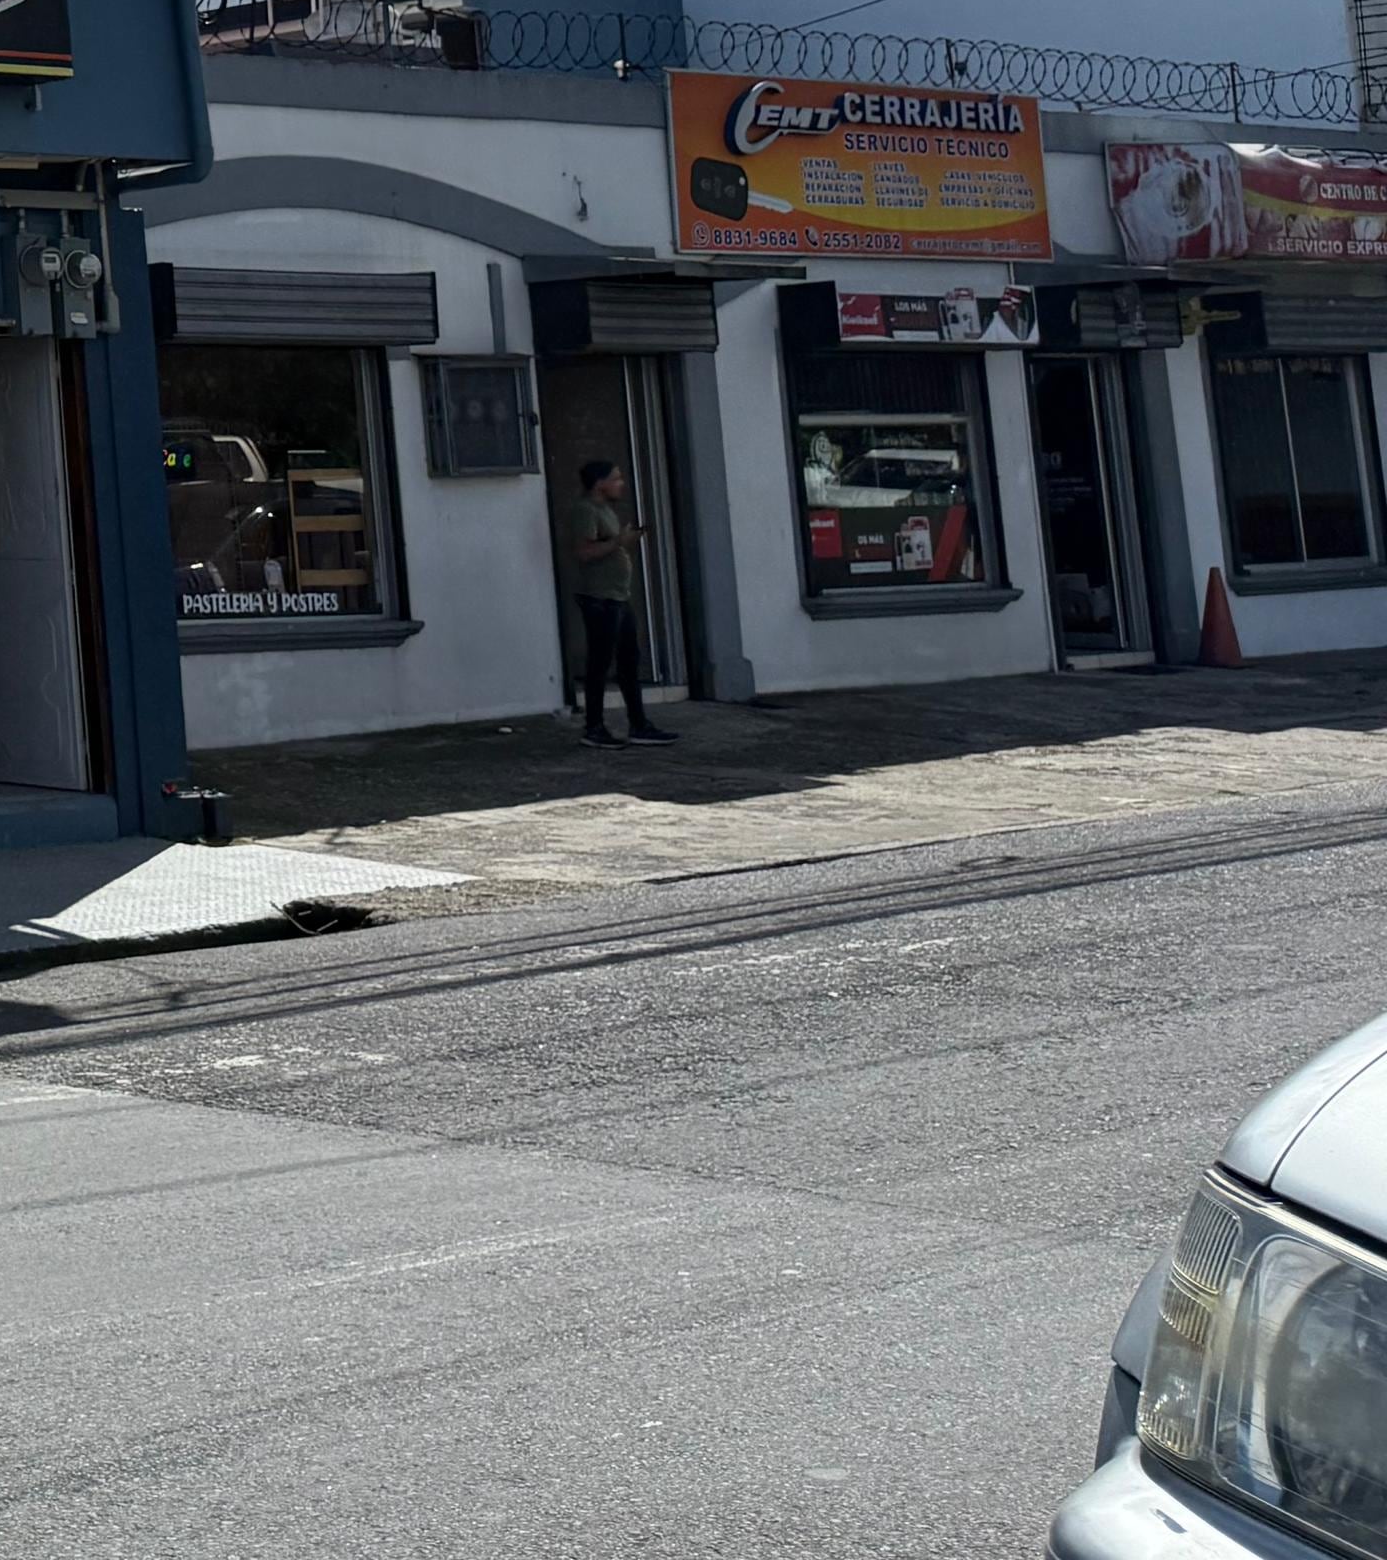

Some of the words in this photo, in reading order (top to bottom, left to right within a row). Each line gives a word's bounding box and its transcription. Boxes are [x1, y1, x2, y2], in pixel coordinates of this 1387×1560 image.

[842, 89, 1025, 133] CERRAJERÍA
[844, 133, 928, 154] SERVICIO
[1320, 183, 1361, 200] CENTRO
[1363, 185, 1378, 200] DE
[714, 229, 797, 246] 8831-9684
[823, 232, 901, 249] 2551-2082
[282, 591, 339, 612] POSTRES
